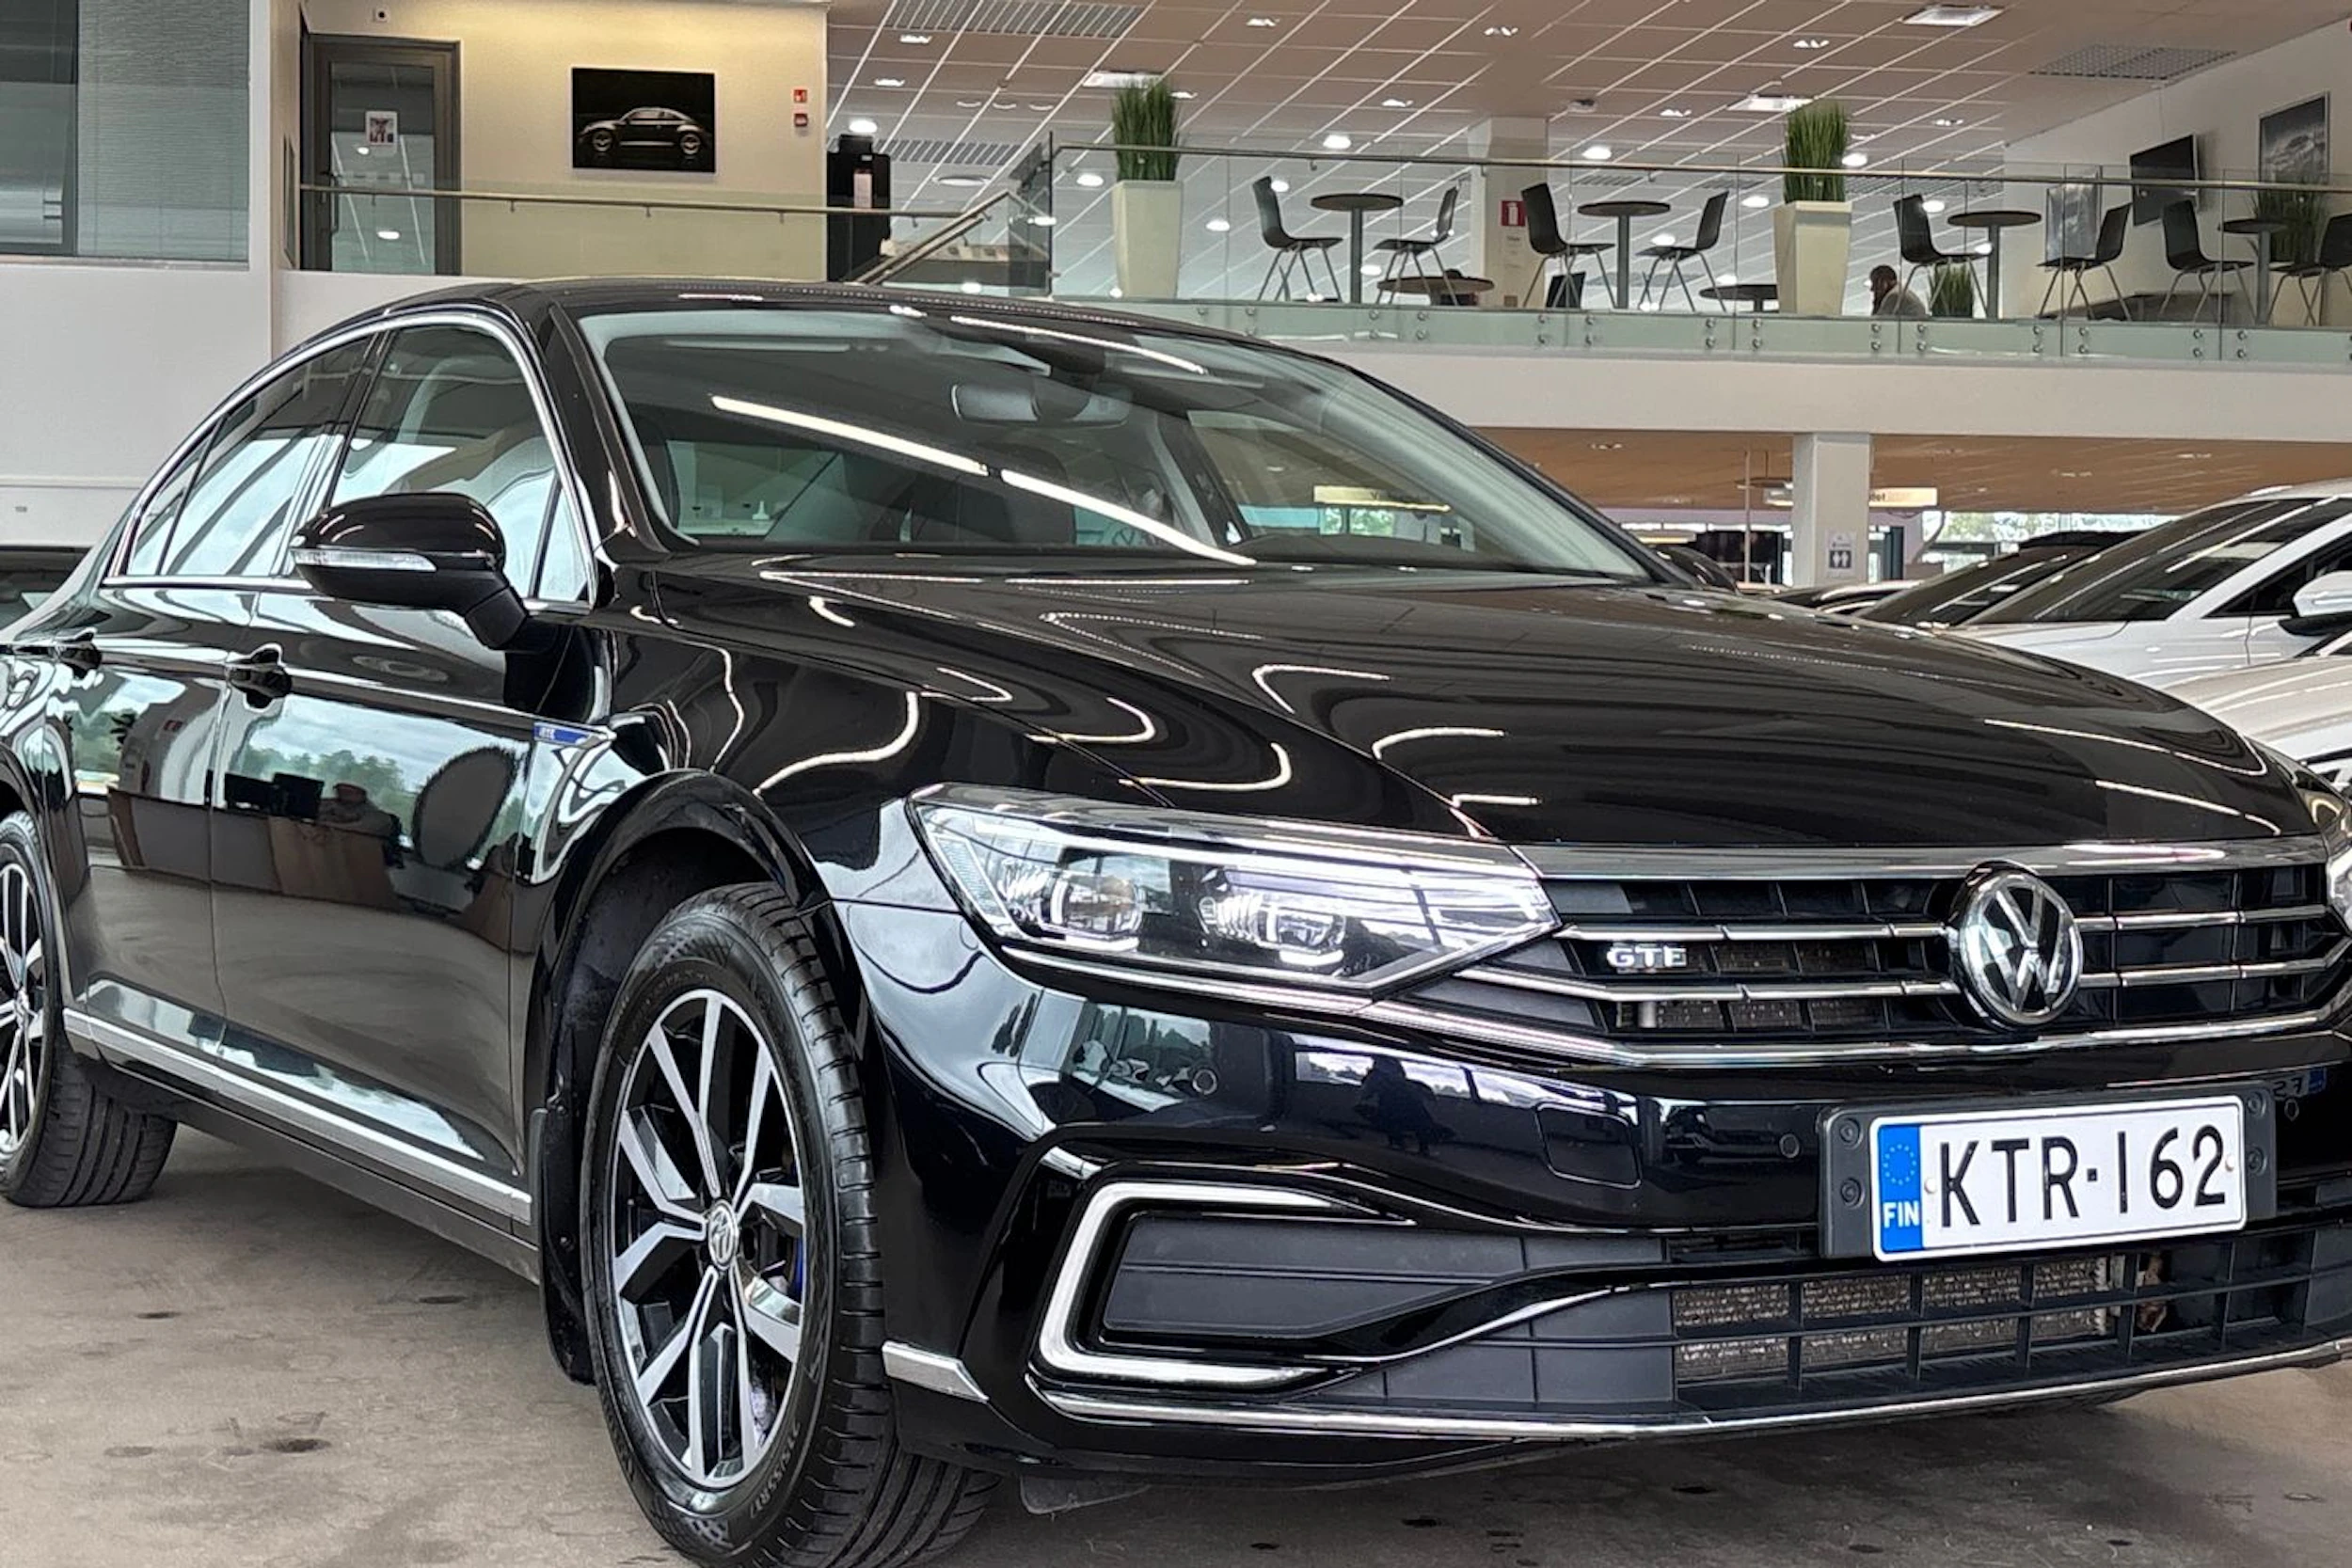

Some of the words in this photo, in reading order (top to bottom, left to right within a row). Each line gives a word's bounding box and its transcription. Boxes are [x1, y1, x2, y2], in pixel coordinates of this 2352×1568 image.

[1606, 944, 1687, 968] GTE
[1939, 1124, 2227, 1228] KTR-162
[1883, 1200, 1921, 1228] FIN
